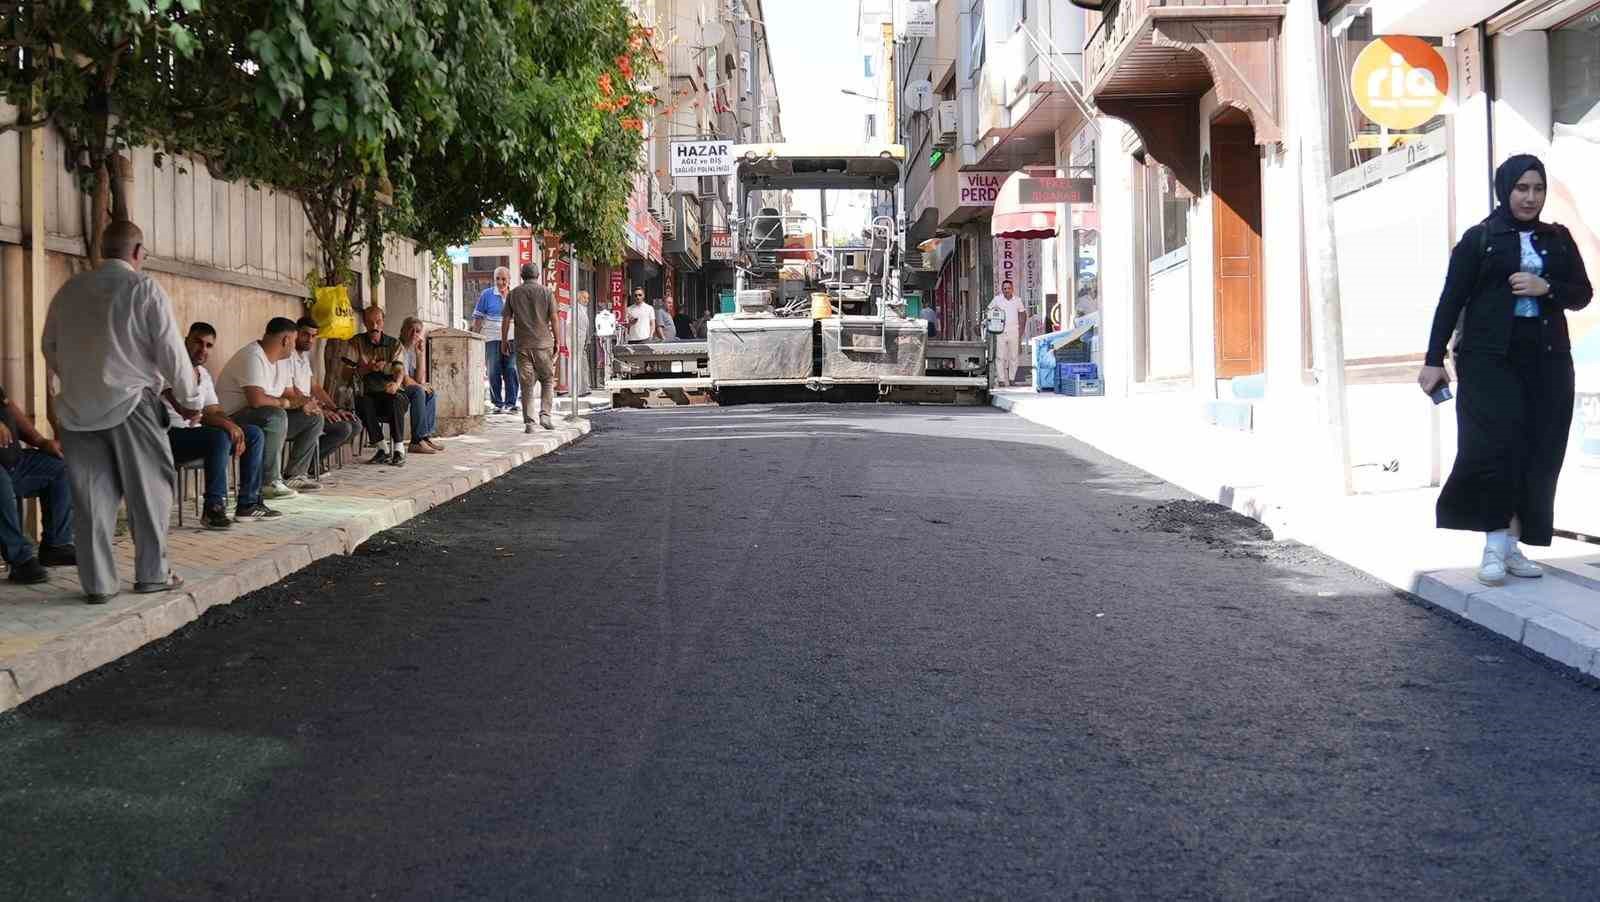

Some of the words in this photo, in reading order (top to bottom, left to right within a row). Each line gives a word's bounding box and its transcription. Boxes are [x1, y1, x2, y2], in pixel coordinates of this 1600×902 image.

[677, 144, 728, 157] HAZAR
[968, 174, 999, 187] VİLLA
[961, 188, 1000, 202] PERD
